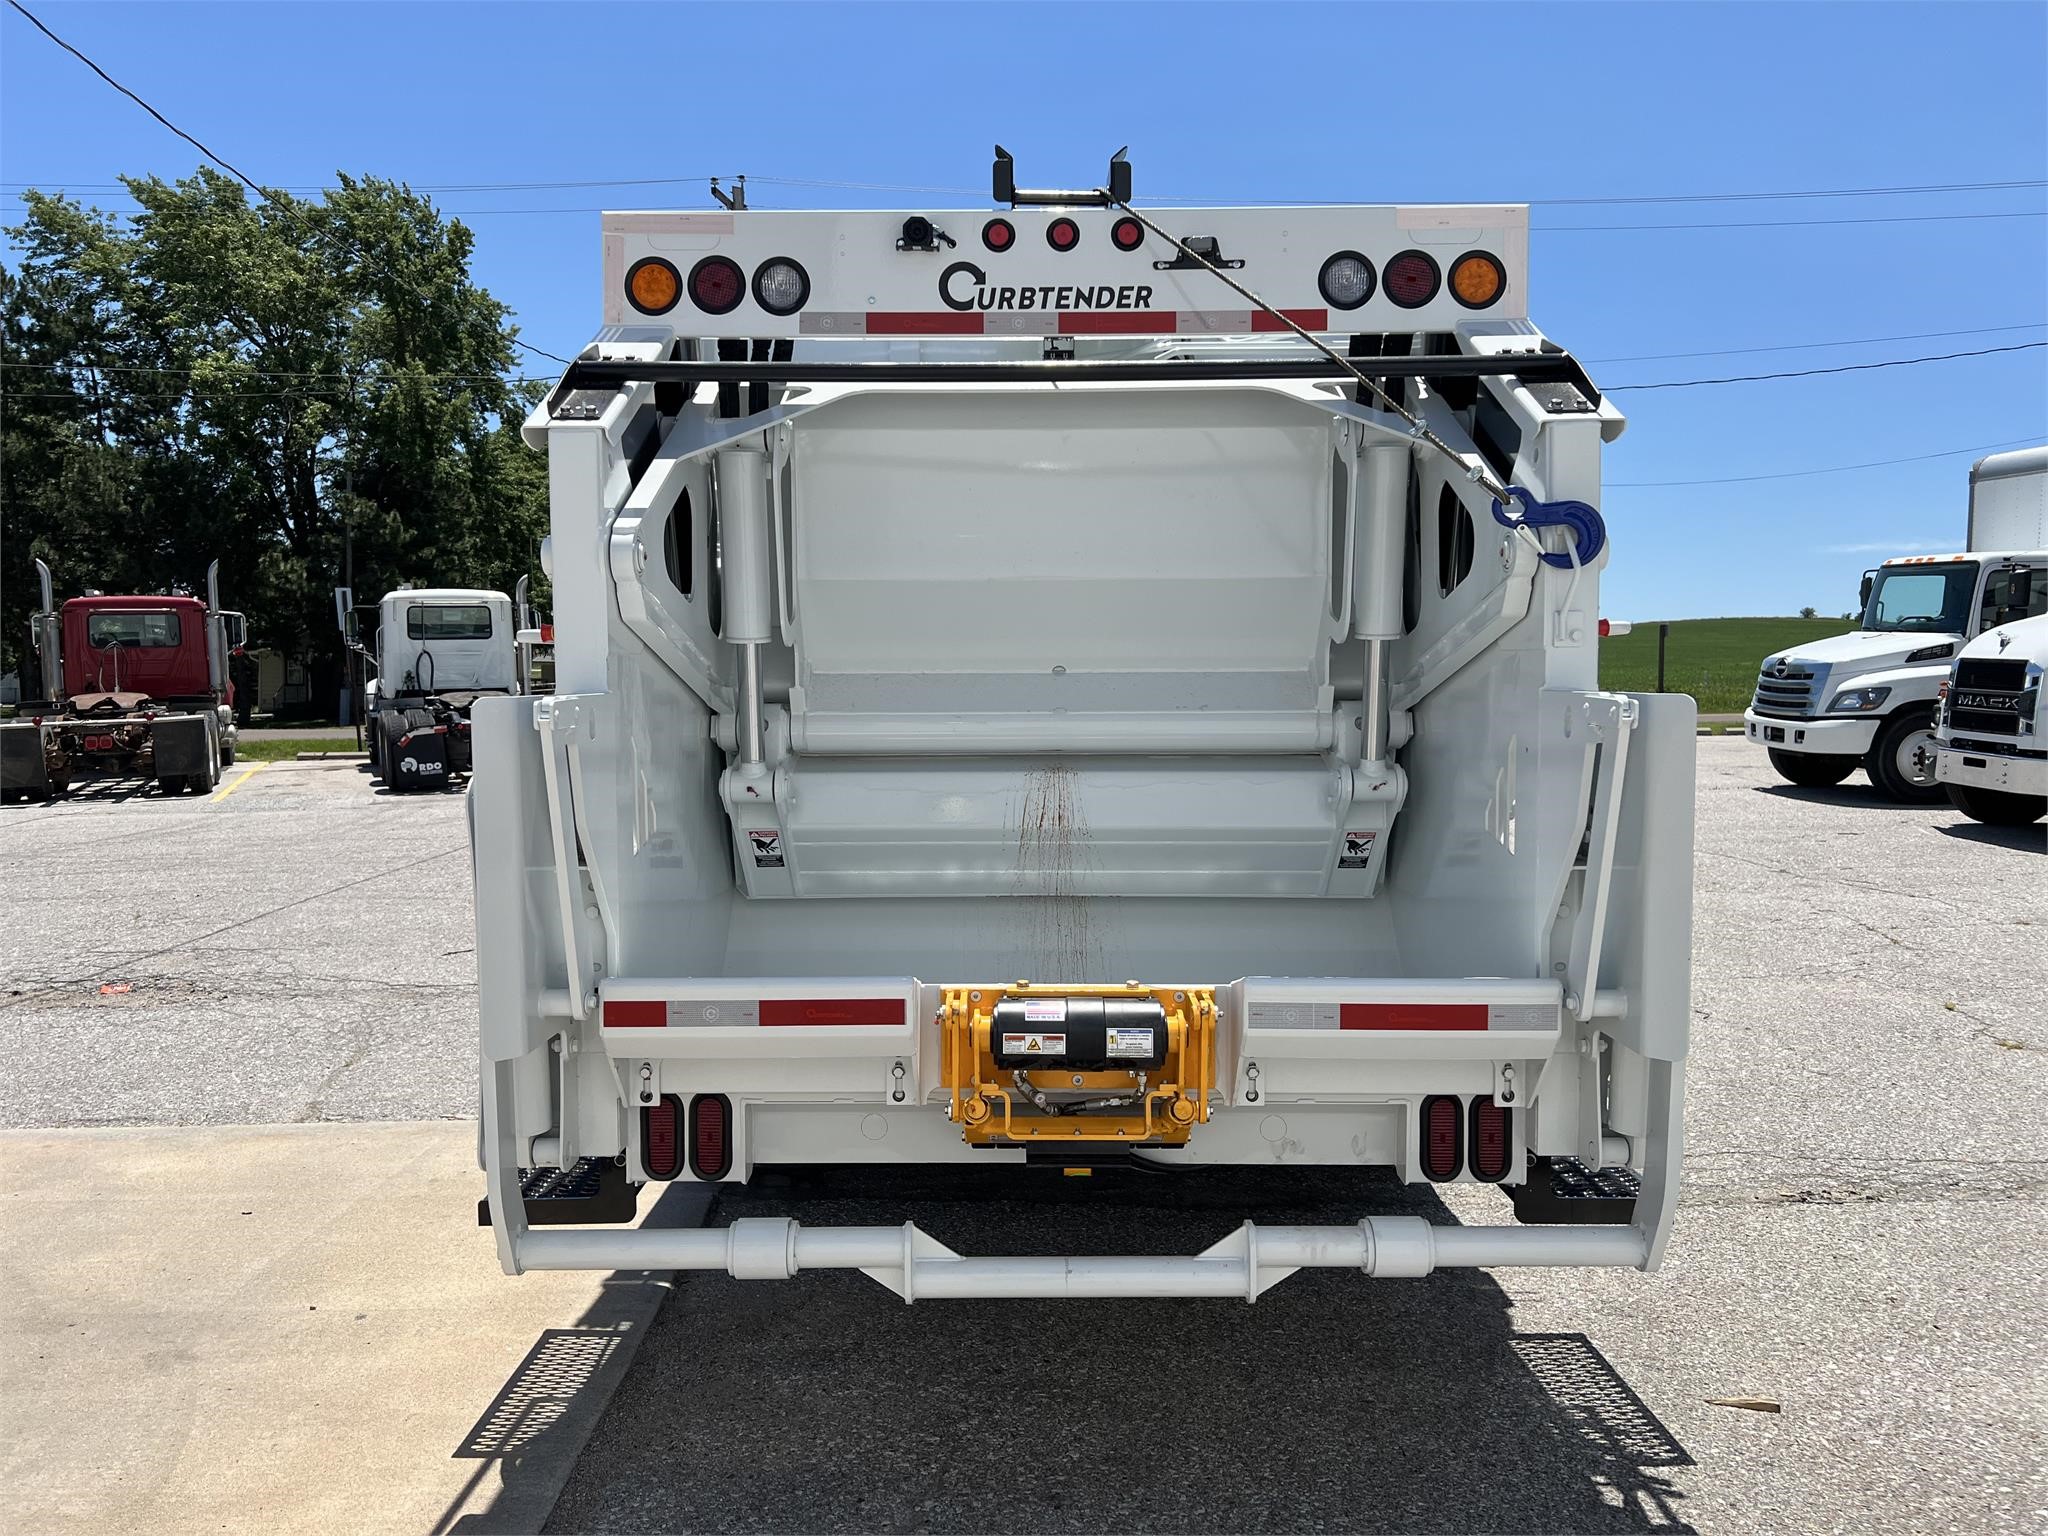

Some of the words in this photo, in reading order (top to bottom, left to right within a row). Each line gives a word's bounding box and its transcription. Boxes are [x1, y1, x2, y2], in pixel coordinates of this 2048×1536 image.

[938, 261, 1153, 311] CURBTENDER
[1958, 694, 2019, 709] MACK
[418, 762, 442, 771] RDO
